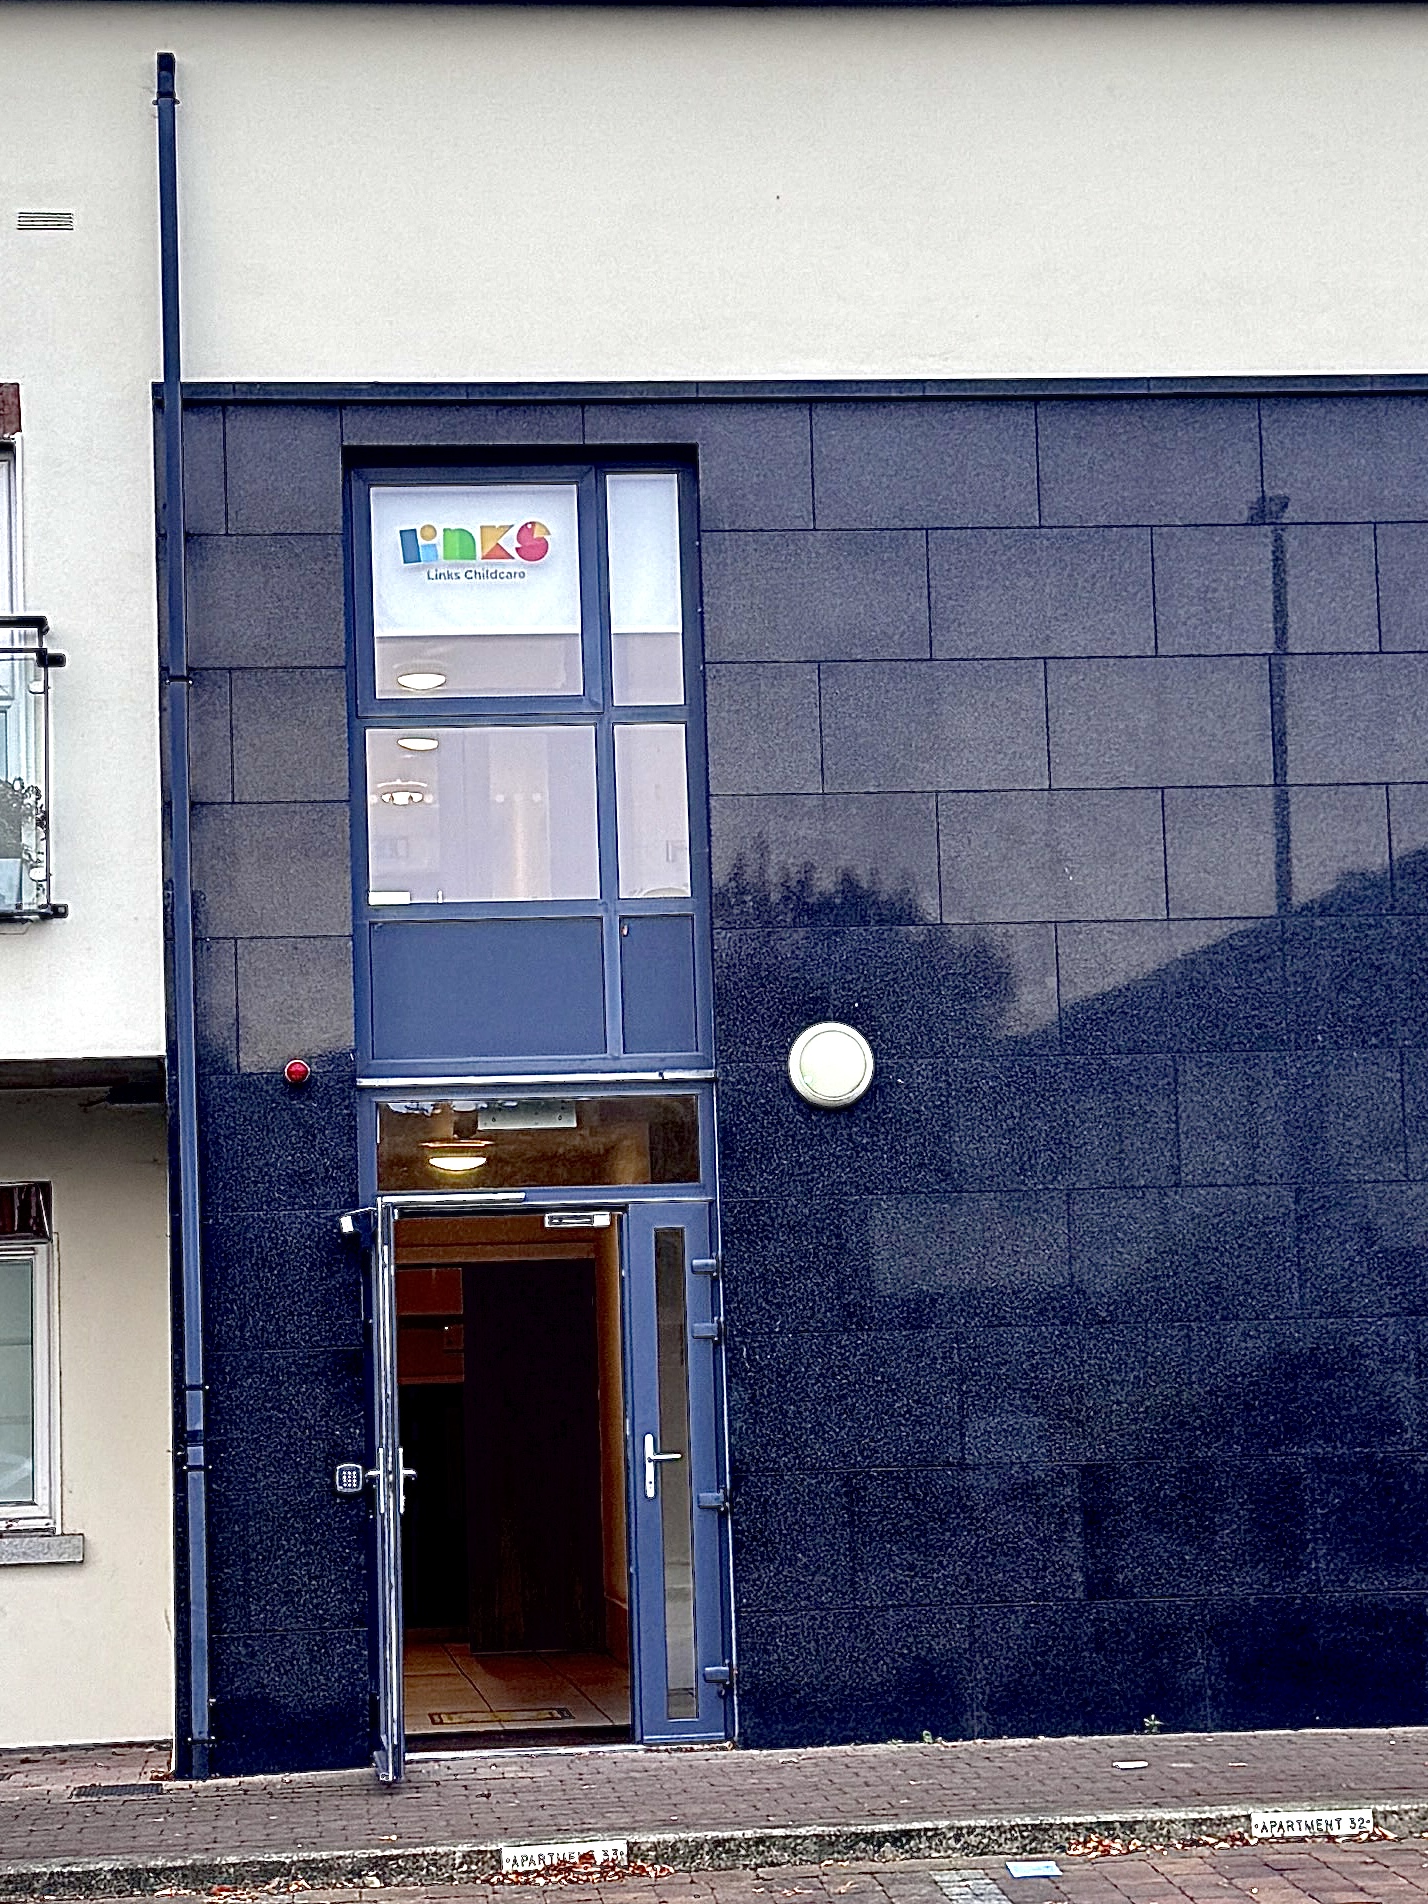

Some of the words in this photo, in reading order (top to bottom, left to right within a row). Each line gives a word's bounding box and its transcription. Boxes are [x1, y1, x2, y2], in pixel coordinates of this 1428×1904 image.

[427, 569, 460, 581] Links
[1260, 1817, 1342, 1834] APARTMENT
[1349, 1816, 1367, 1830] 32
[512, 1850, 594, 1867] APARTME
